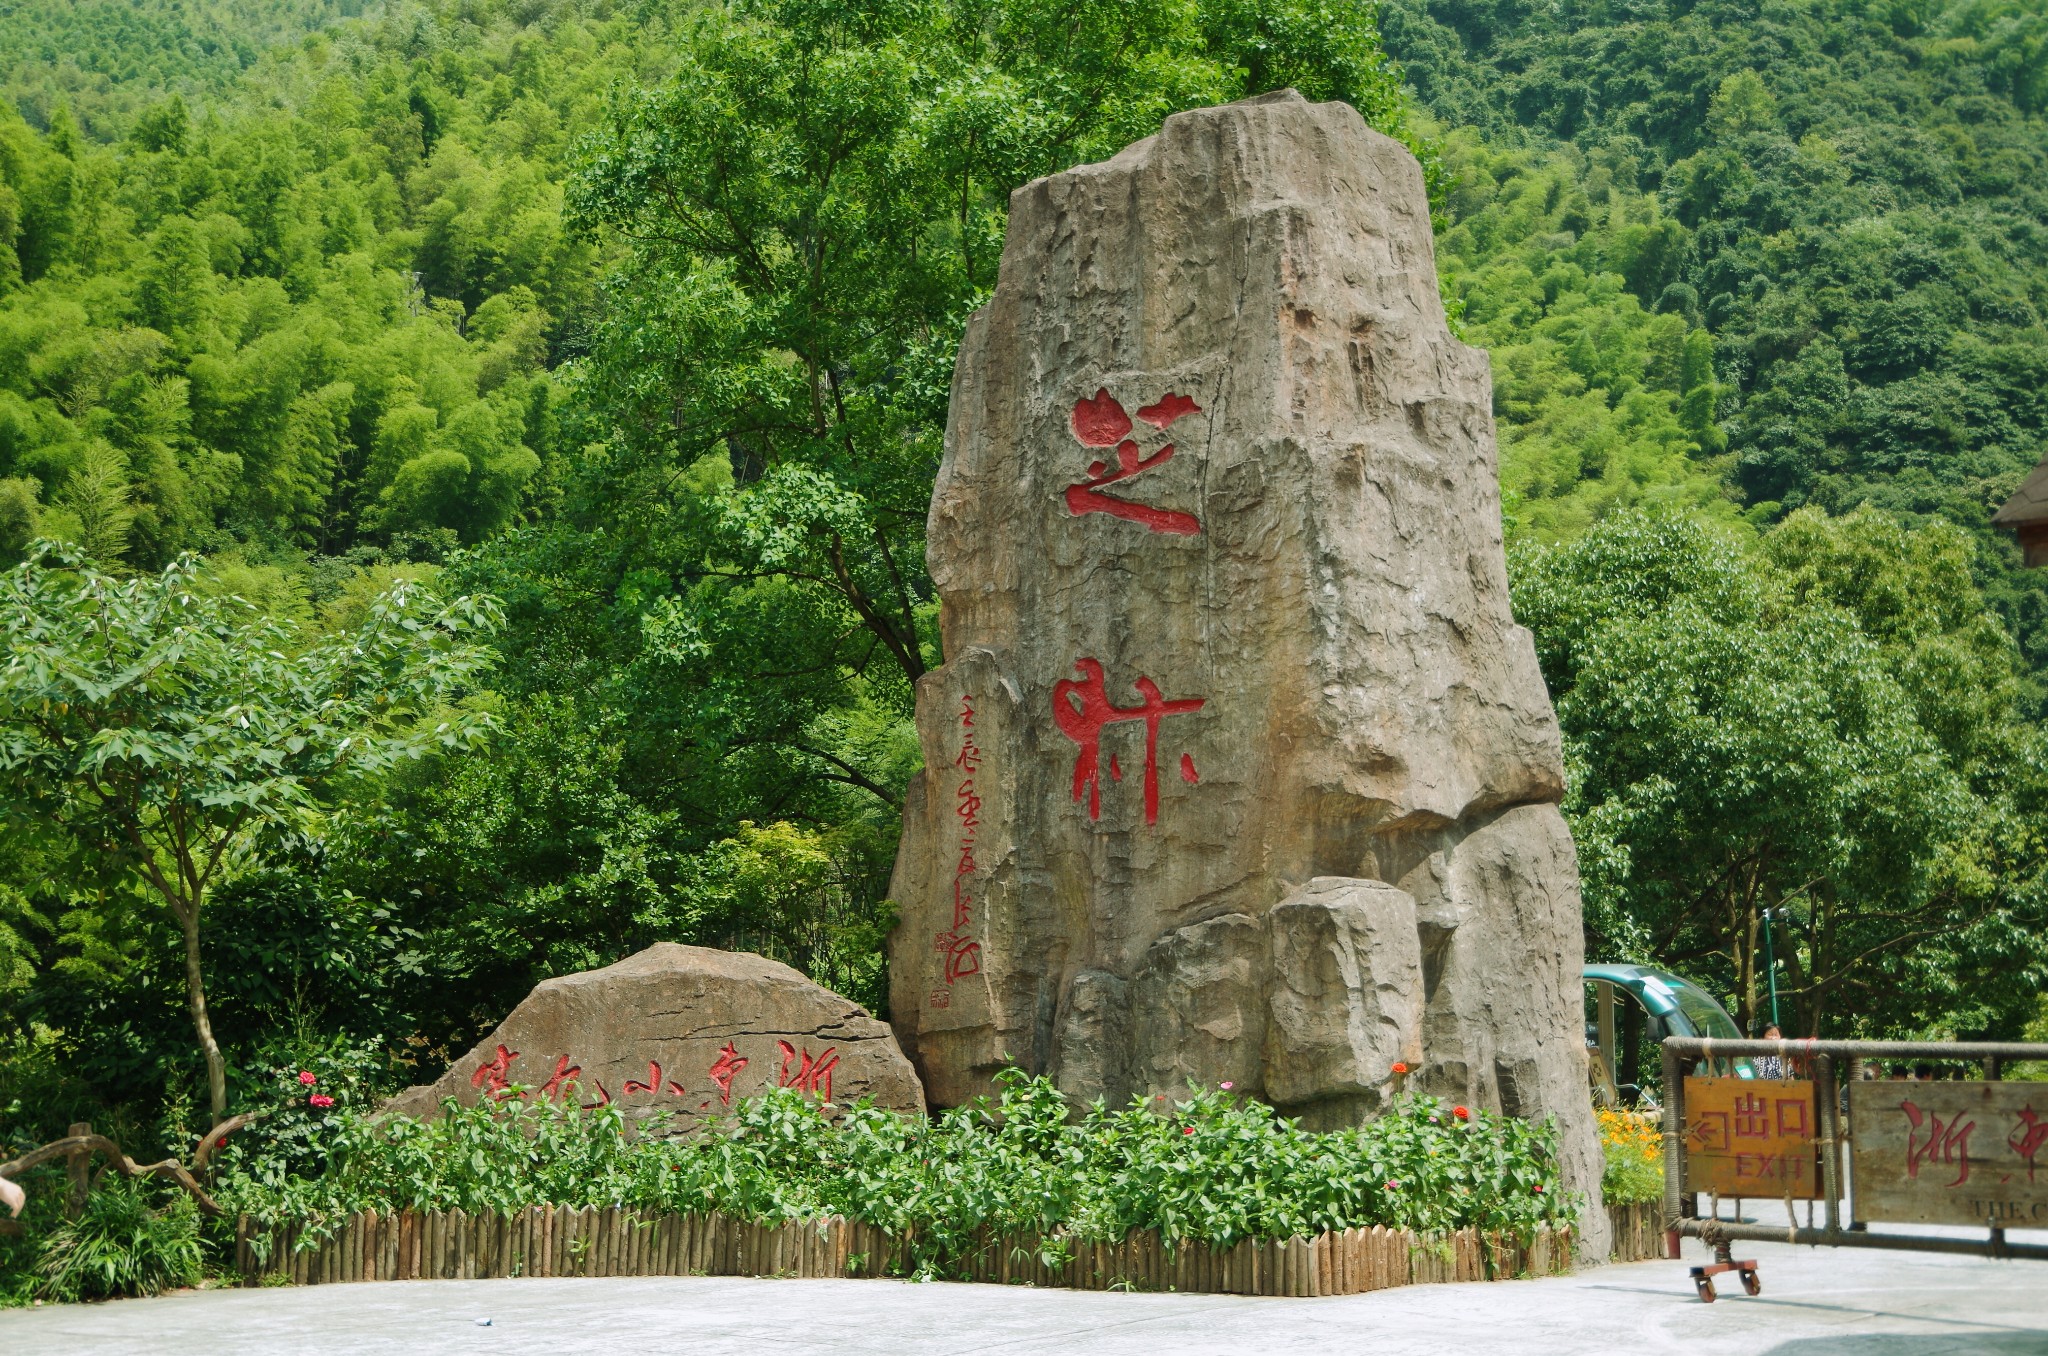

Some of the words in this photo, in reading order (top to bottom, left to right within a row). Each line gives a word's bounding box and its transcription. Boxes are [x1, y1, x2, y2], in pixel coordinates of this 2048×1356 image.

[1735, 1092, 1808, 1139] 出口
[1736, 1151, 1808, 1180] EXIT
[1968, 1199, 2025, 1220] THE
